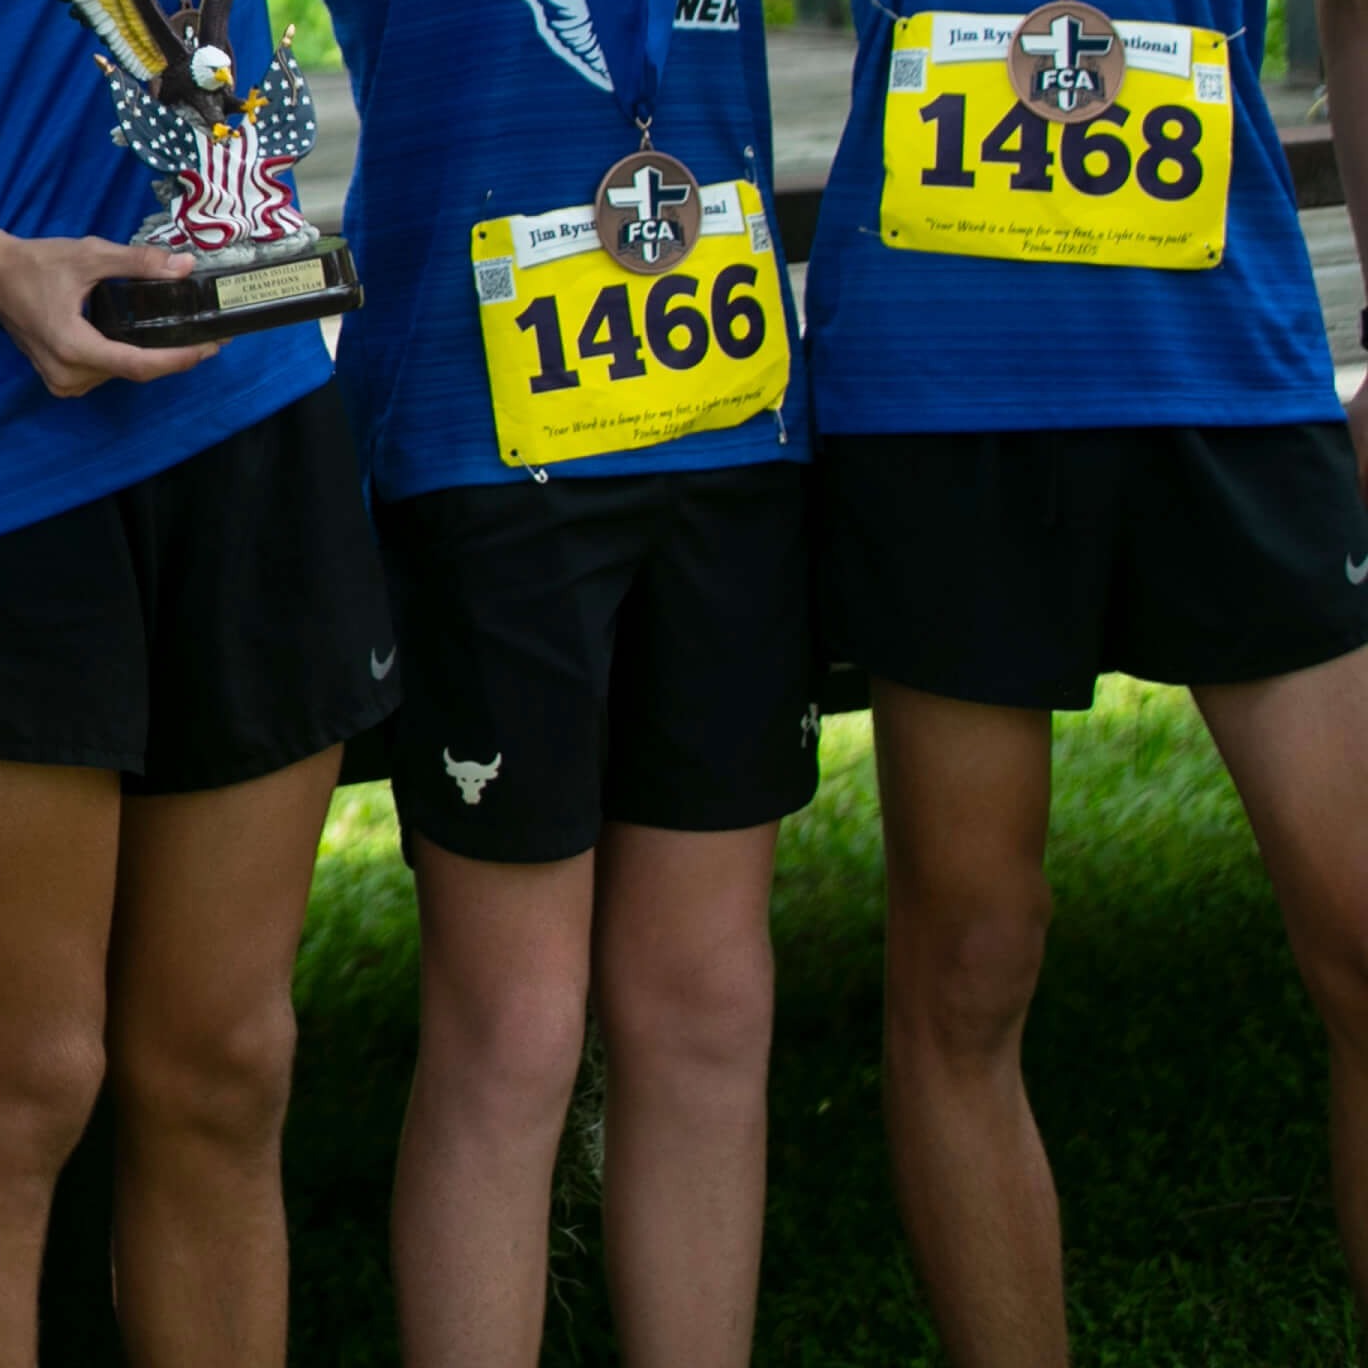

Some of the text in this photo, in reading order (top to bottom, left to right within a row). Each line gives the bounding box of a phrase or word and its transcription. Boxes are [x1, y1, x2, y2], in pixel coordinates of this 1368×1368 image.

[949, 29, 978, 46] Jim
[1041, 70, 1095, 90] FCA
[919, 92, 1203, 202] 1468
[529, 229, 556, 248] Jim
[628, 220, 675, 243] FCA
[515, 263, 766, 395] 1466
